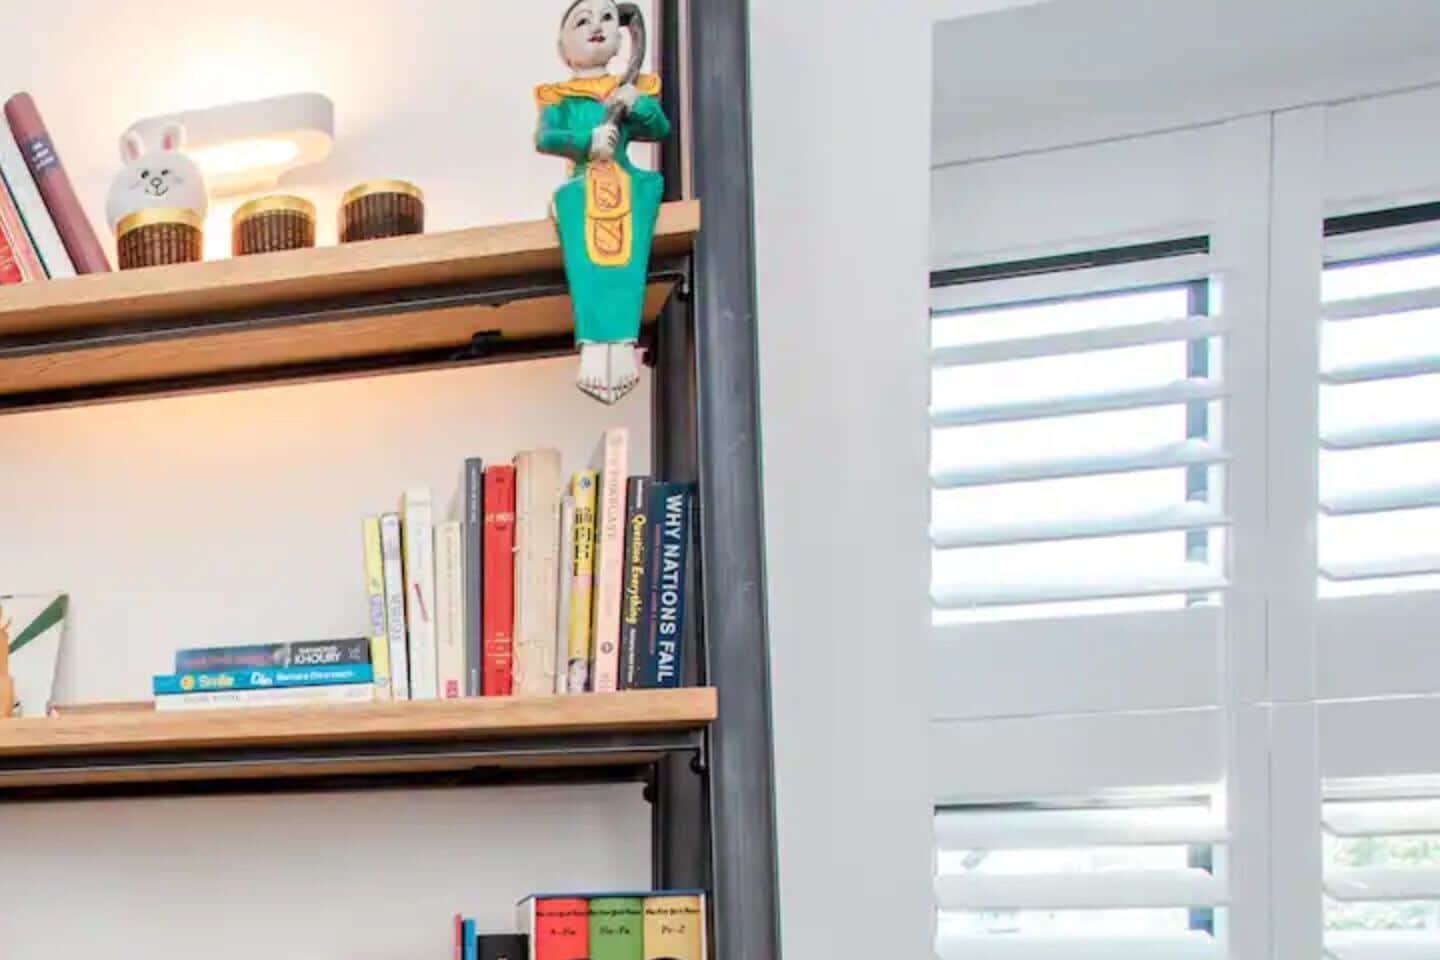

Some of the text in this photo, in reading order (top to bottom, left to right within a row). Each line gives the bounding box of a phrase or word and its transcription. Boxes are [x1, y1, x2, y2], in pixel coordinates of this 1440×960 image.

[632, 514, 646, 564] Question
[626, 567, 644, 625] Everything
[657, 495, 682, 683] WHY NATIONS FAIL
